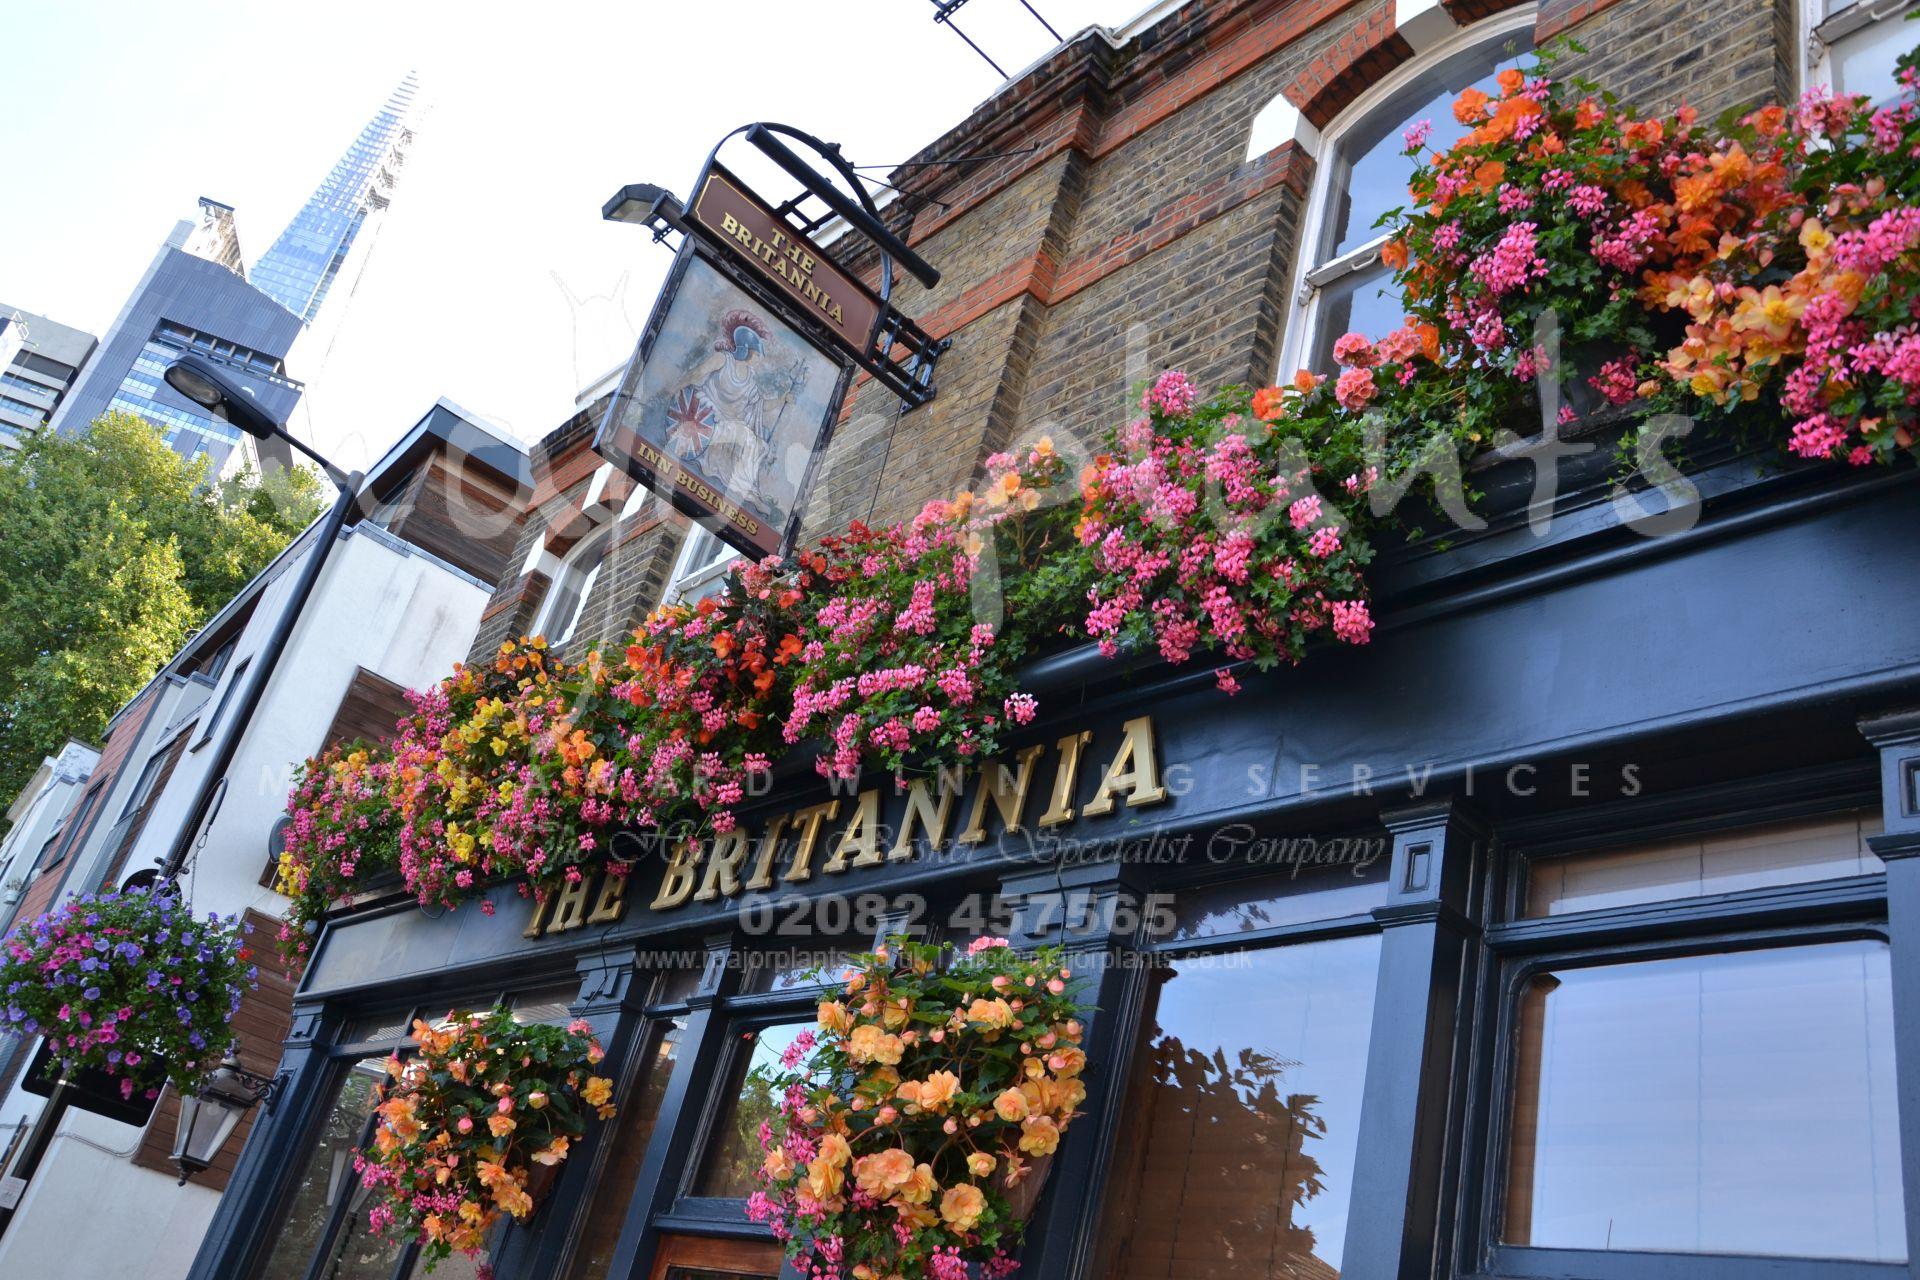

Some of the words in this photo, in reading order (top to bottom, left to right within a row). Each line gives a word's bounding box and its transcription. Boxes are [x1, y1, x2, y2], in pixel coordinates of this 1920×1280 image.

[719, 212, 844, 324] BRITANNIA
[770, 226, 816, 276] THE
[637, 442, 672, 476] INN
[675, 467, 758, 536] BUSINESS
[649, 714, 1167, 910] BRITANNIA
